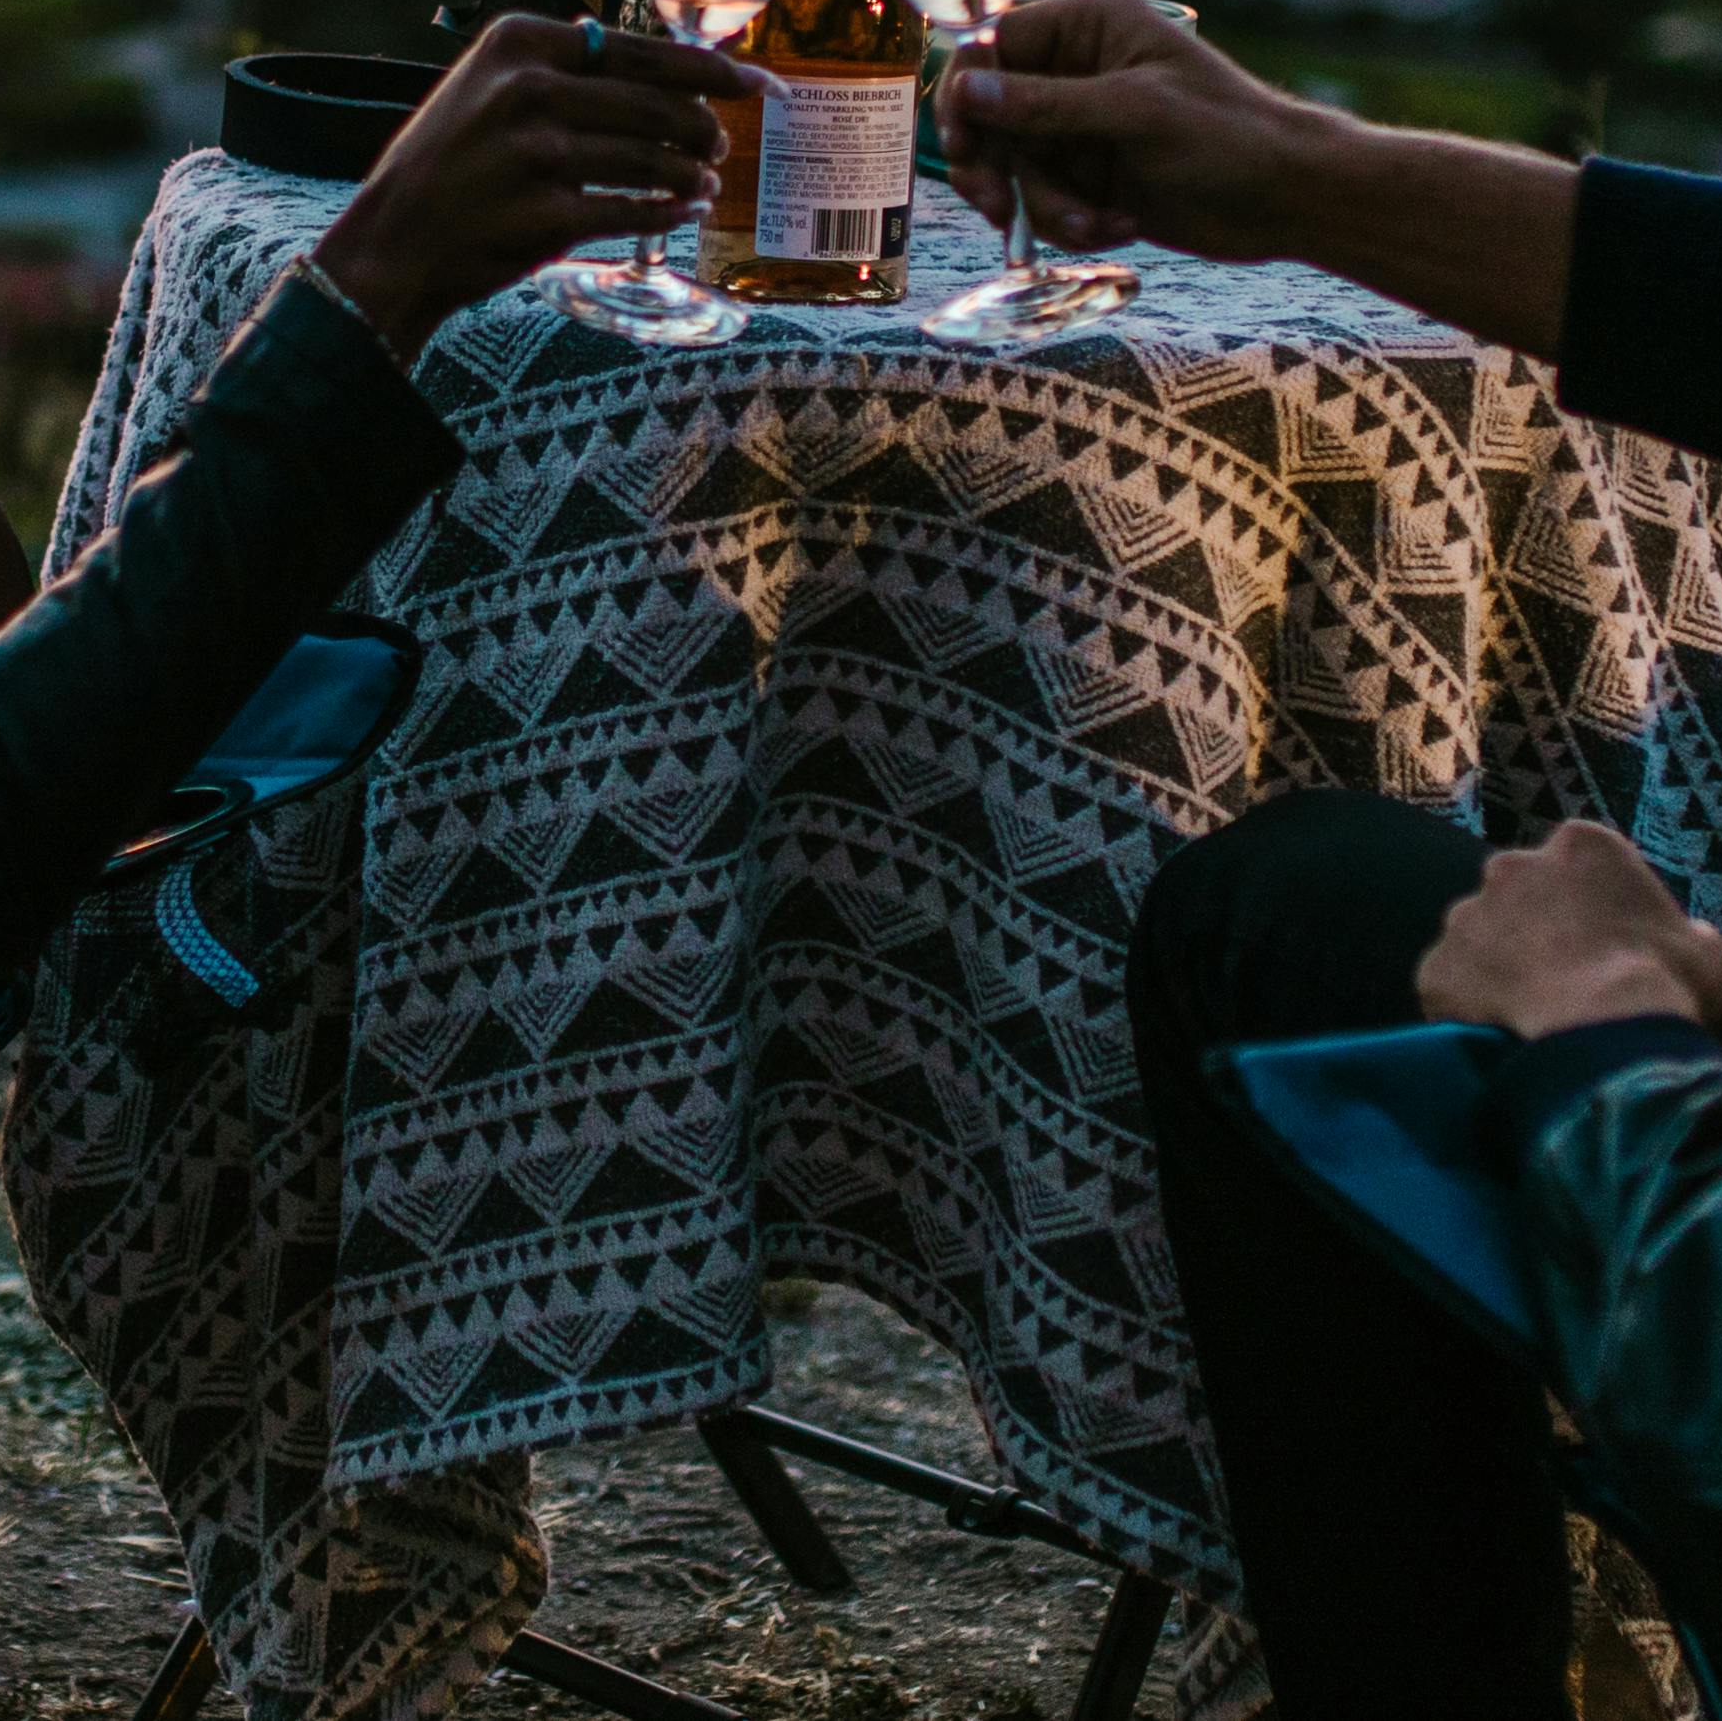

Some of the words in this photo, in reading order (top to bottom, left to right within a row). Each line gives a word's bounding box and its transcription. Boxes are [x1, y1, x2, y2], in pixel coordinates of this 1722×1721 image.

[791, 88, 849, 101] SCHLOSS
[853, 89, 901, 101] BIEBRICH
[783, 103, 821, 112] QUALITY
[822, 105, 866, 113] SPARKLING
[833, 115, 852, 123] ROSÉ
[788, 122, 821, 130] PRODUCED
[766, 153, 804, 163] GOVERNMENT
[759, 229, 773, 243] 750
